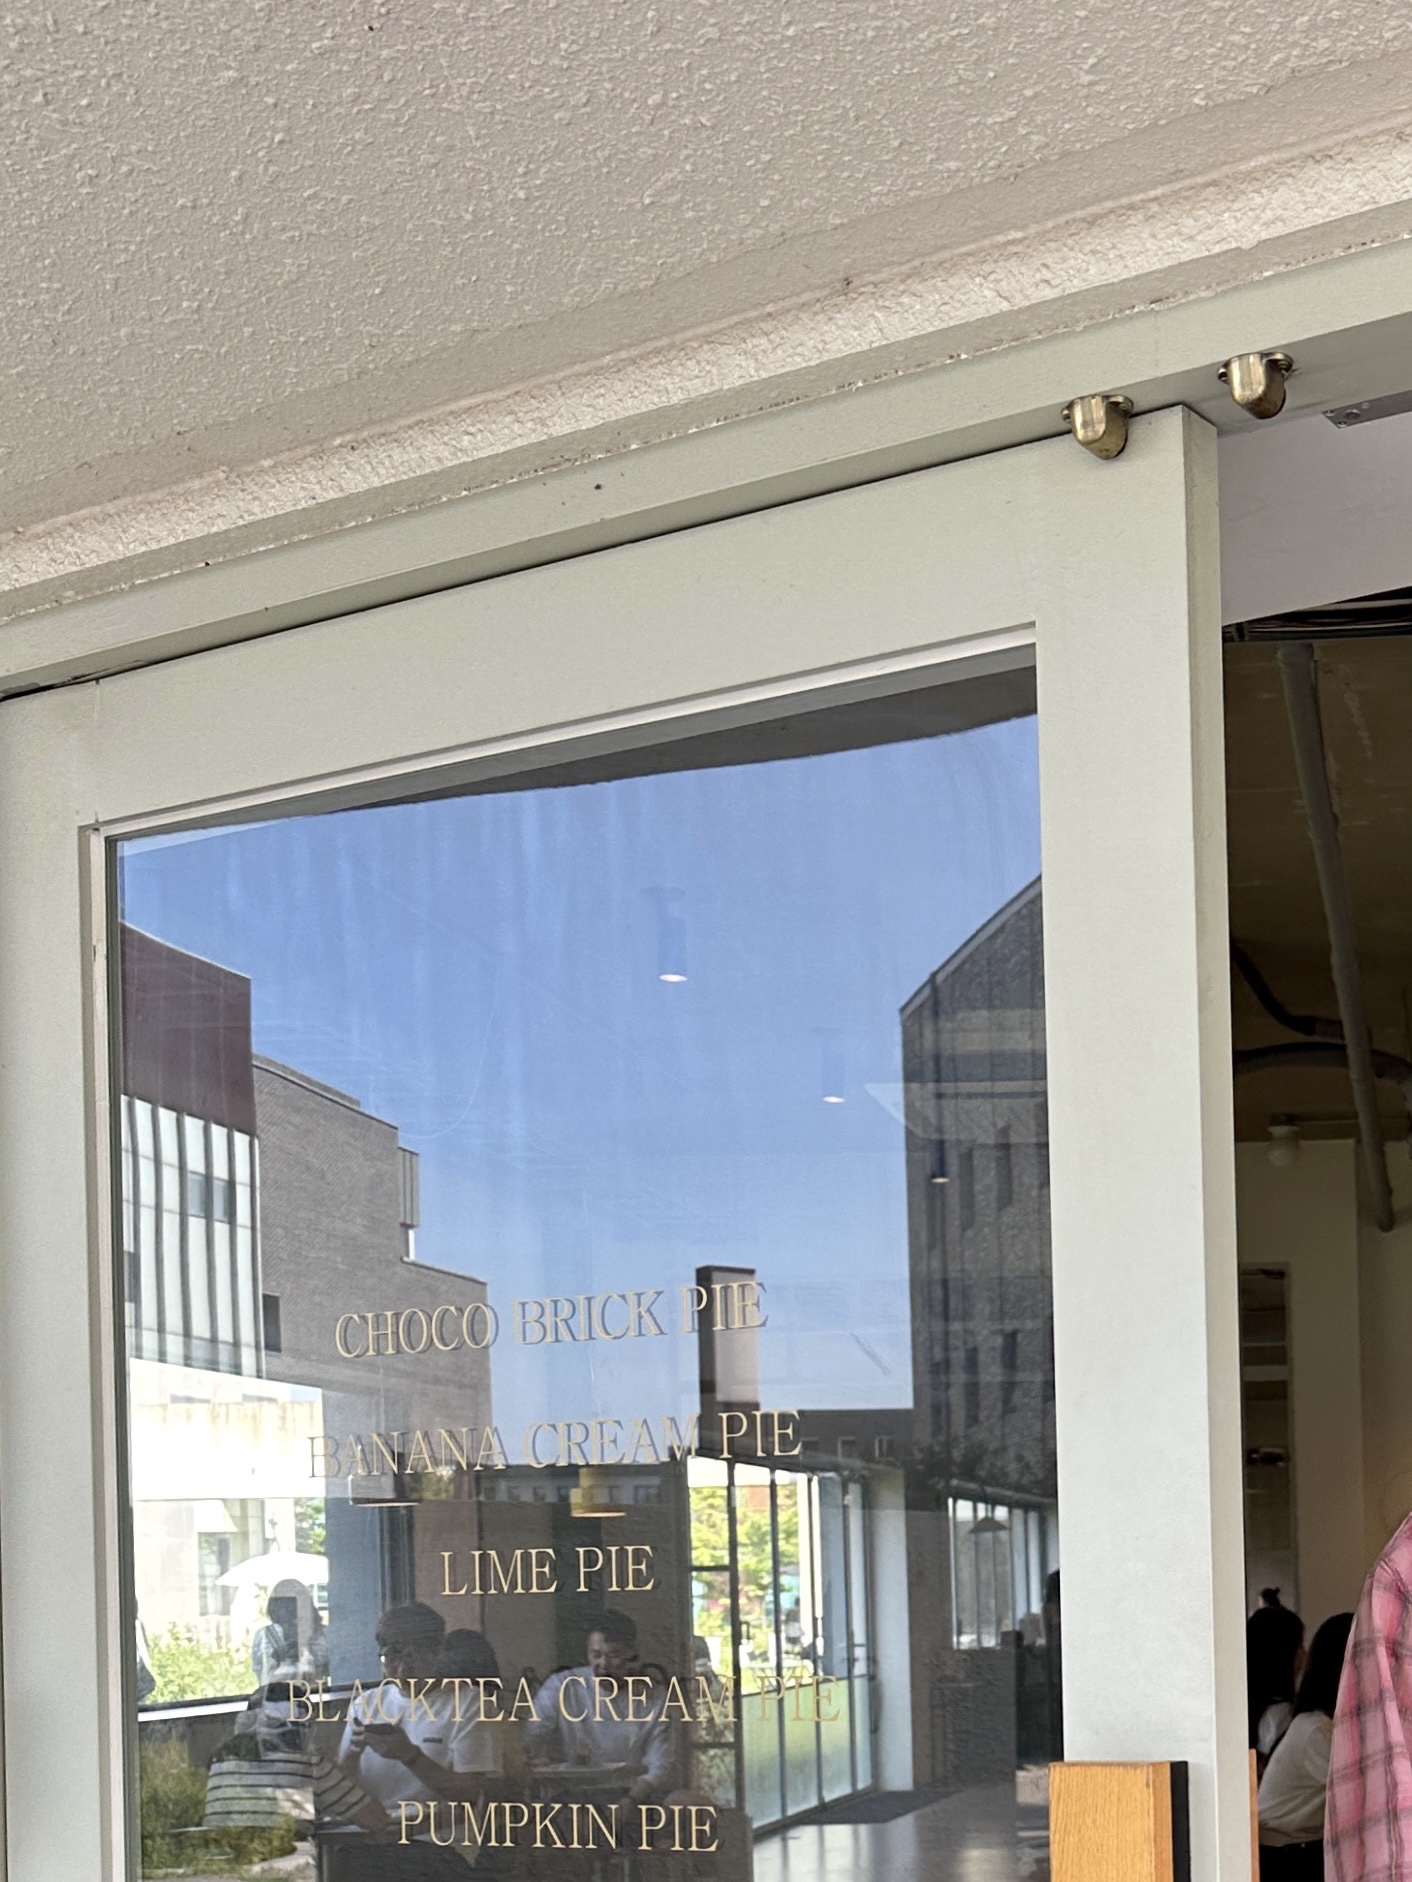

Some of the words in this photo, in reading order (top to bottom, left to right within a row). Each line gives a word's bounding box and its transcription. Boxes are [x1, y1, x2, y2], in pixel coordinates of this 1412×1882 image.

[335, 1302, 492, 1359] CHOCO
[511, 1290, 664, 1345] BRICK
[680, 1281, 766, 1333] PIE
[307, 1425, 507, 1479] BANANA
[523, 1414, 699, 1467] CREAM
[718, 1410, 801, 1459] PIE
[440, 1548, 558, 1596] LIME
[575, 1545, 655, 1593] PIE
[287, 1676, 539, 1723] BLACKTEA
[559, 1675, 738, 1723] CREAM
[757, 1675, 840, 1723] PIE
[397, 1801, 623, 1850] PUMPKIN
[637, 1804, 719, 1853] PIE
